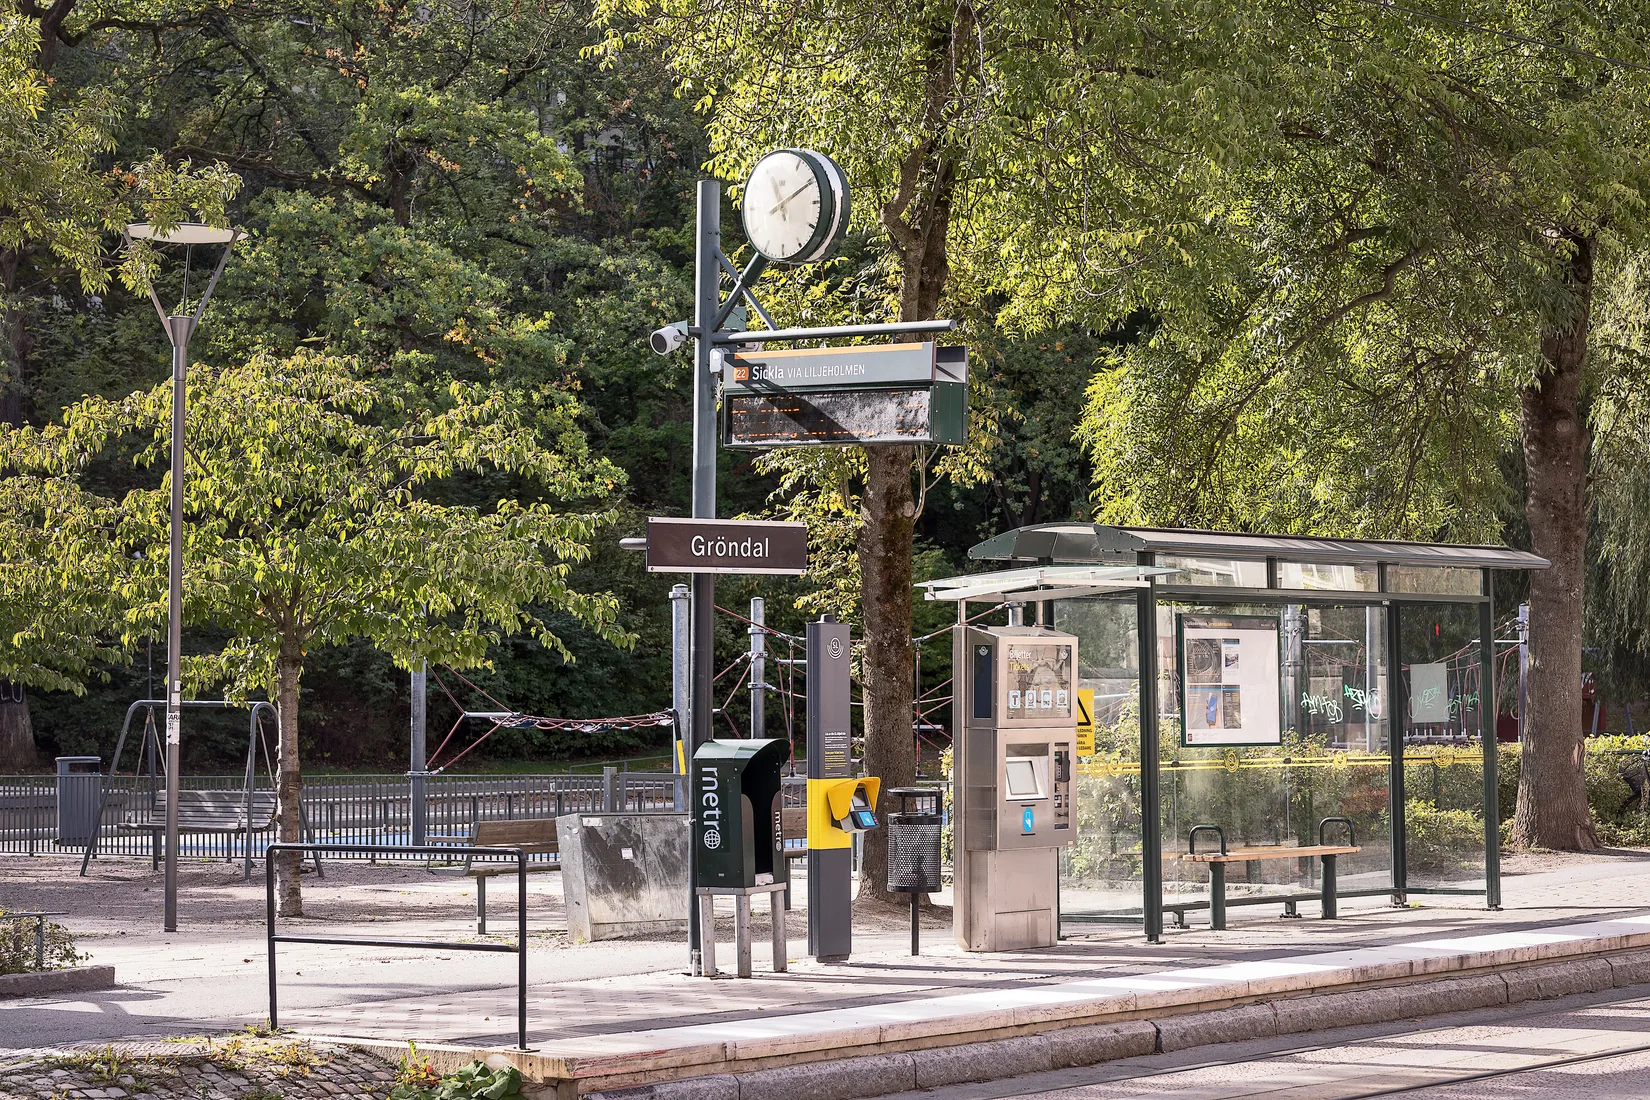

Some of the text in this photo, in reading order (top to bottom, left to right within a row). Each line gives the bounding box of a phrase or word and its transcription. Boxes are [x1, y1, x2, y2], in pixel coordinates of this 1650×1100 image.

[736, 364, 865, 380] 22 Sickla VIA LILJEHOLMEN
[691, 535, 769, 558] Gröndal
